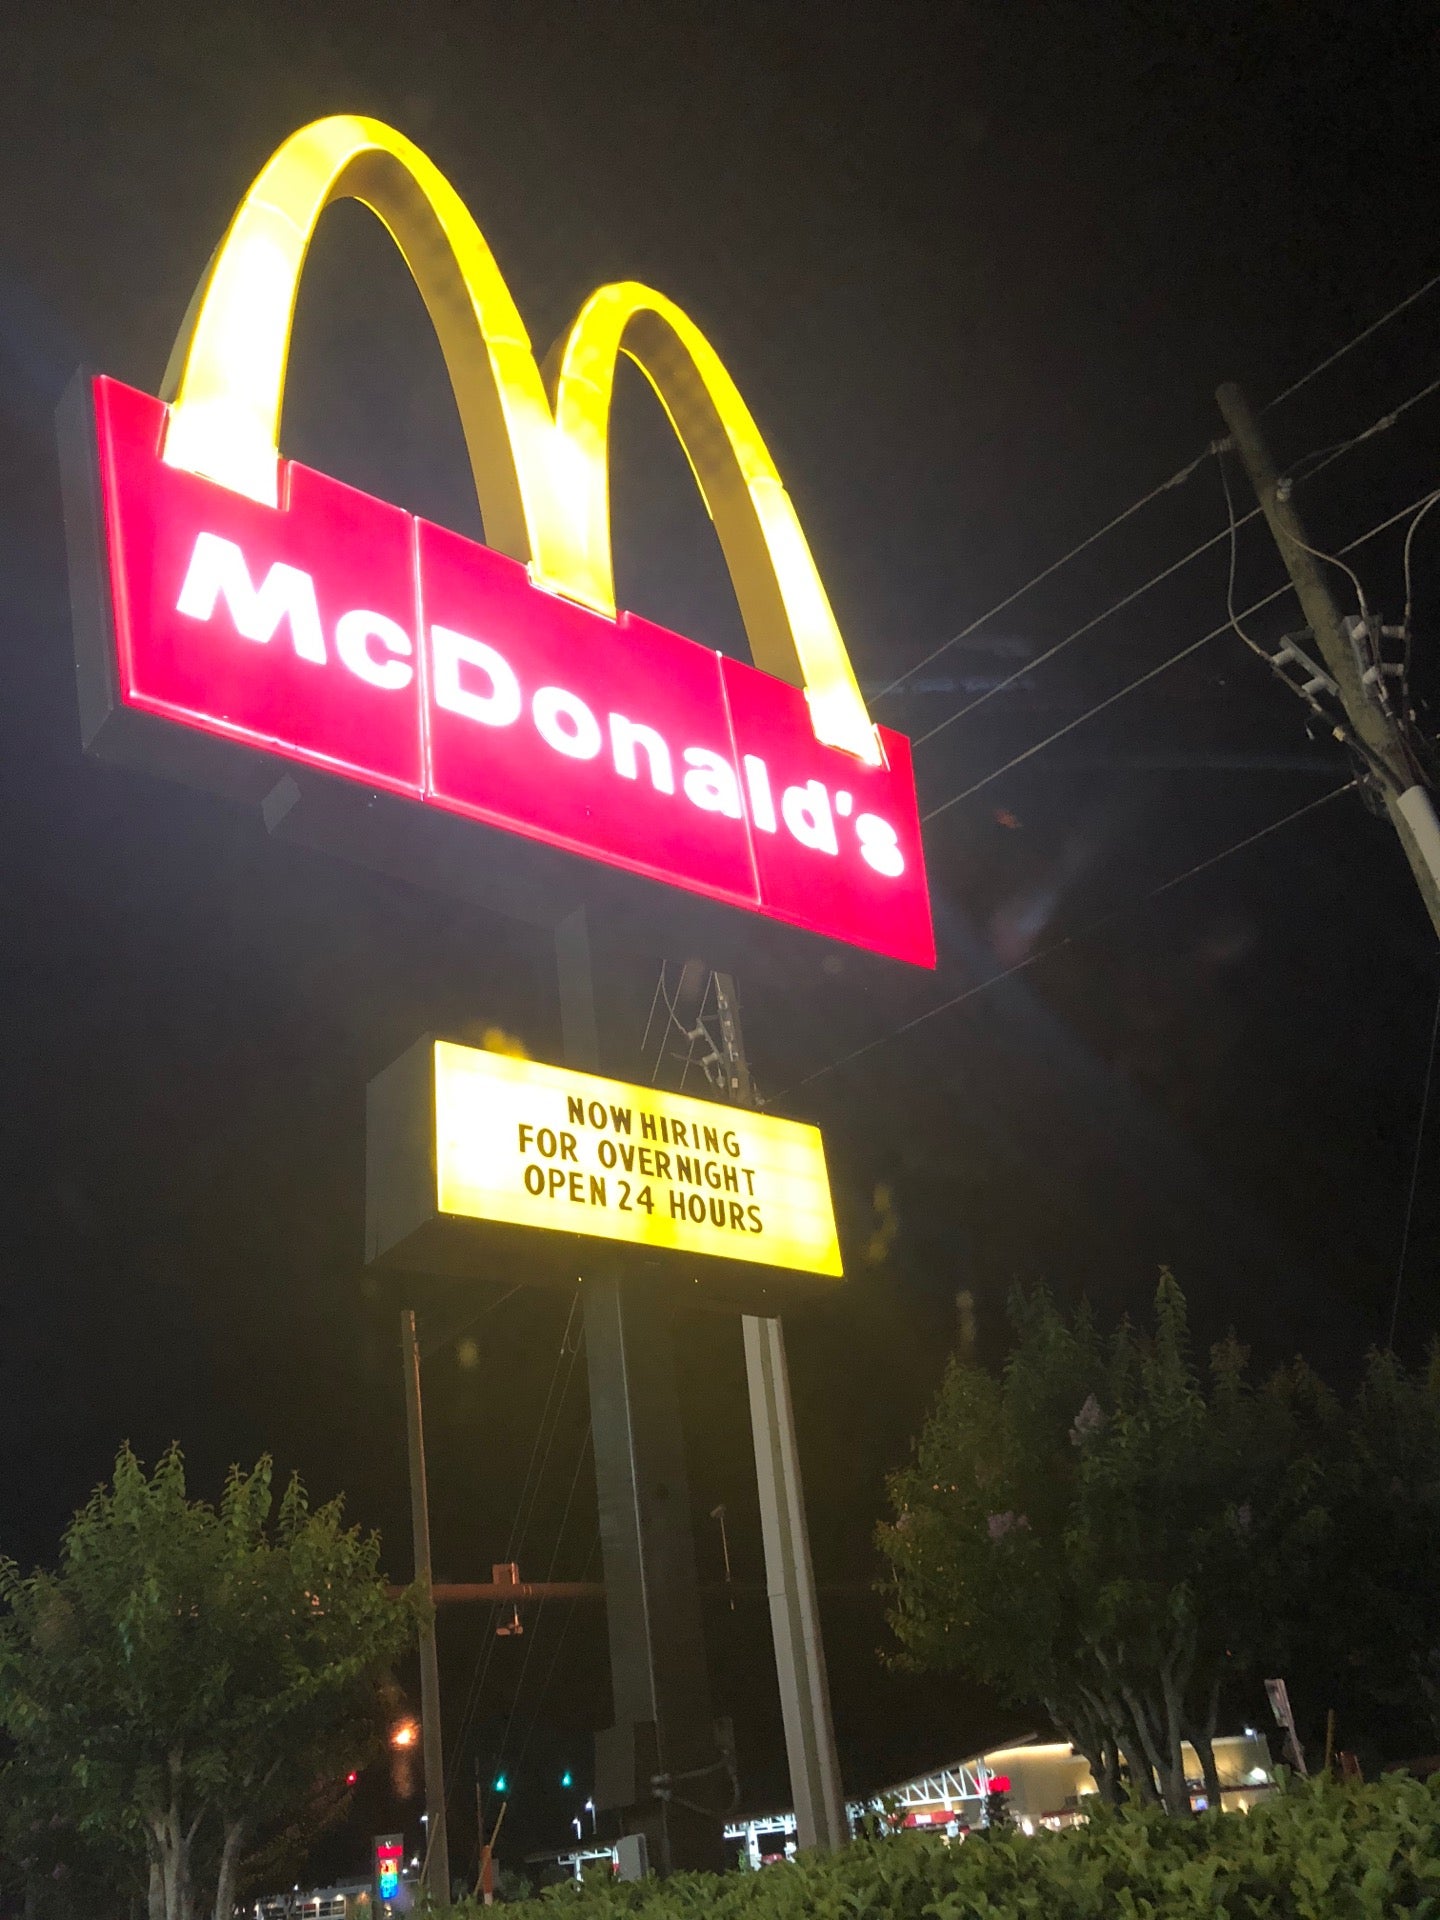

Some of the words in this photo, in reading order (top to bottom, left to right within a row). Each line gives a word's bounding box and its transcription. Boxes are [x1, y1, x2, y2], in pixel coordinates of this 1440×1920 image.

[176, 531, 905, 877] McDonald's
[518, 1123, 578, 1162] FOR
[597, 1140, 755, 1196] OVERNIGHT
[567, 1096, 632, 1135] NOW
[640, 1111, 741, 1158] HIRING
[524, 1164, 607, 1207] OPEN
[617, 1180, 655, 1215] 24
[669, 1189, 763, 1234] HOURS
